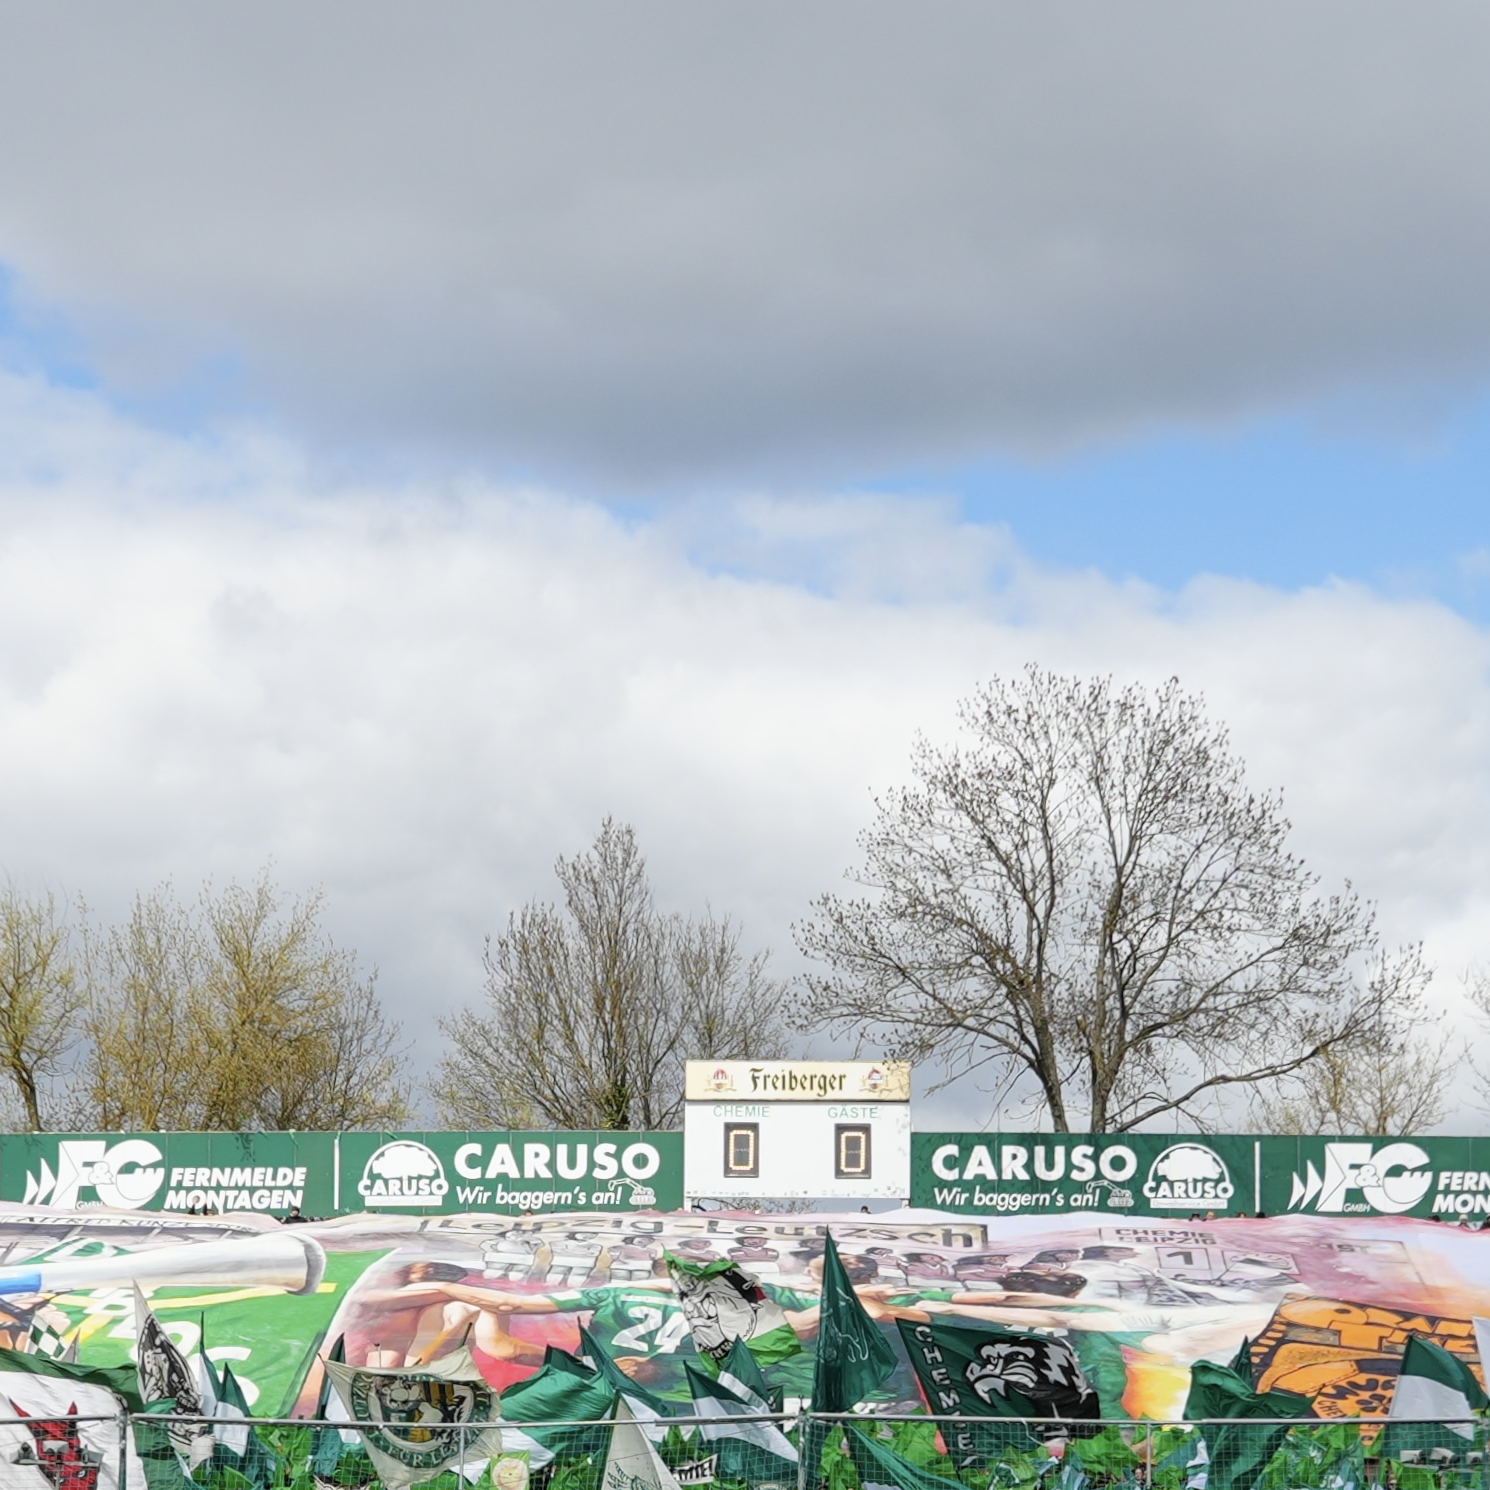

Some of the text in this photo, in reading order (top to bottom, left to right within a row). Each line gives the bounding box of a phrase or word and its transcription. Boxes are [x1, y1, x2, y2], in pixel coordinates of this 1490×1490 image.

[748, 1068, 847, 1097] Freiberger
[713, 1105, 770, 1118] CHEMIE
[827, 1105, 878, 1119] GÄSTE
[454, 1142, 660, 1181] CARUSO
[729, 1129, 754, 1171] 0
[840, 1131, 866, 1173] 0
[931, 1144, 1138, 1182] CARUSO
[170, 1166, 308, 1188] FERNMELDE
[357, 1178, 449, 1197] CARUSO
[1142, 1180, 1235, 1199] CARUSO
[164, 1189, 304, 1210] MONTAGEN
[456, 1184, 622, 1210] Wir baggern's an!
[933, 1184, 1101, 1211] Wir baggern's an!
